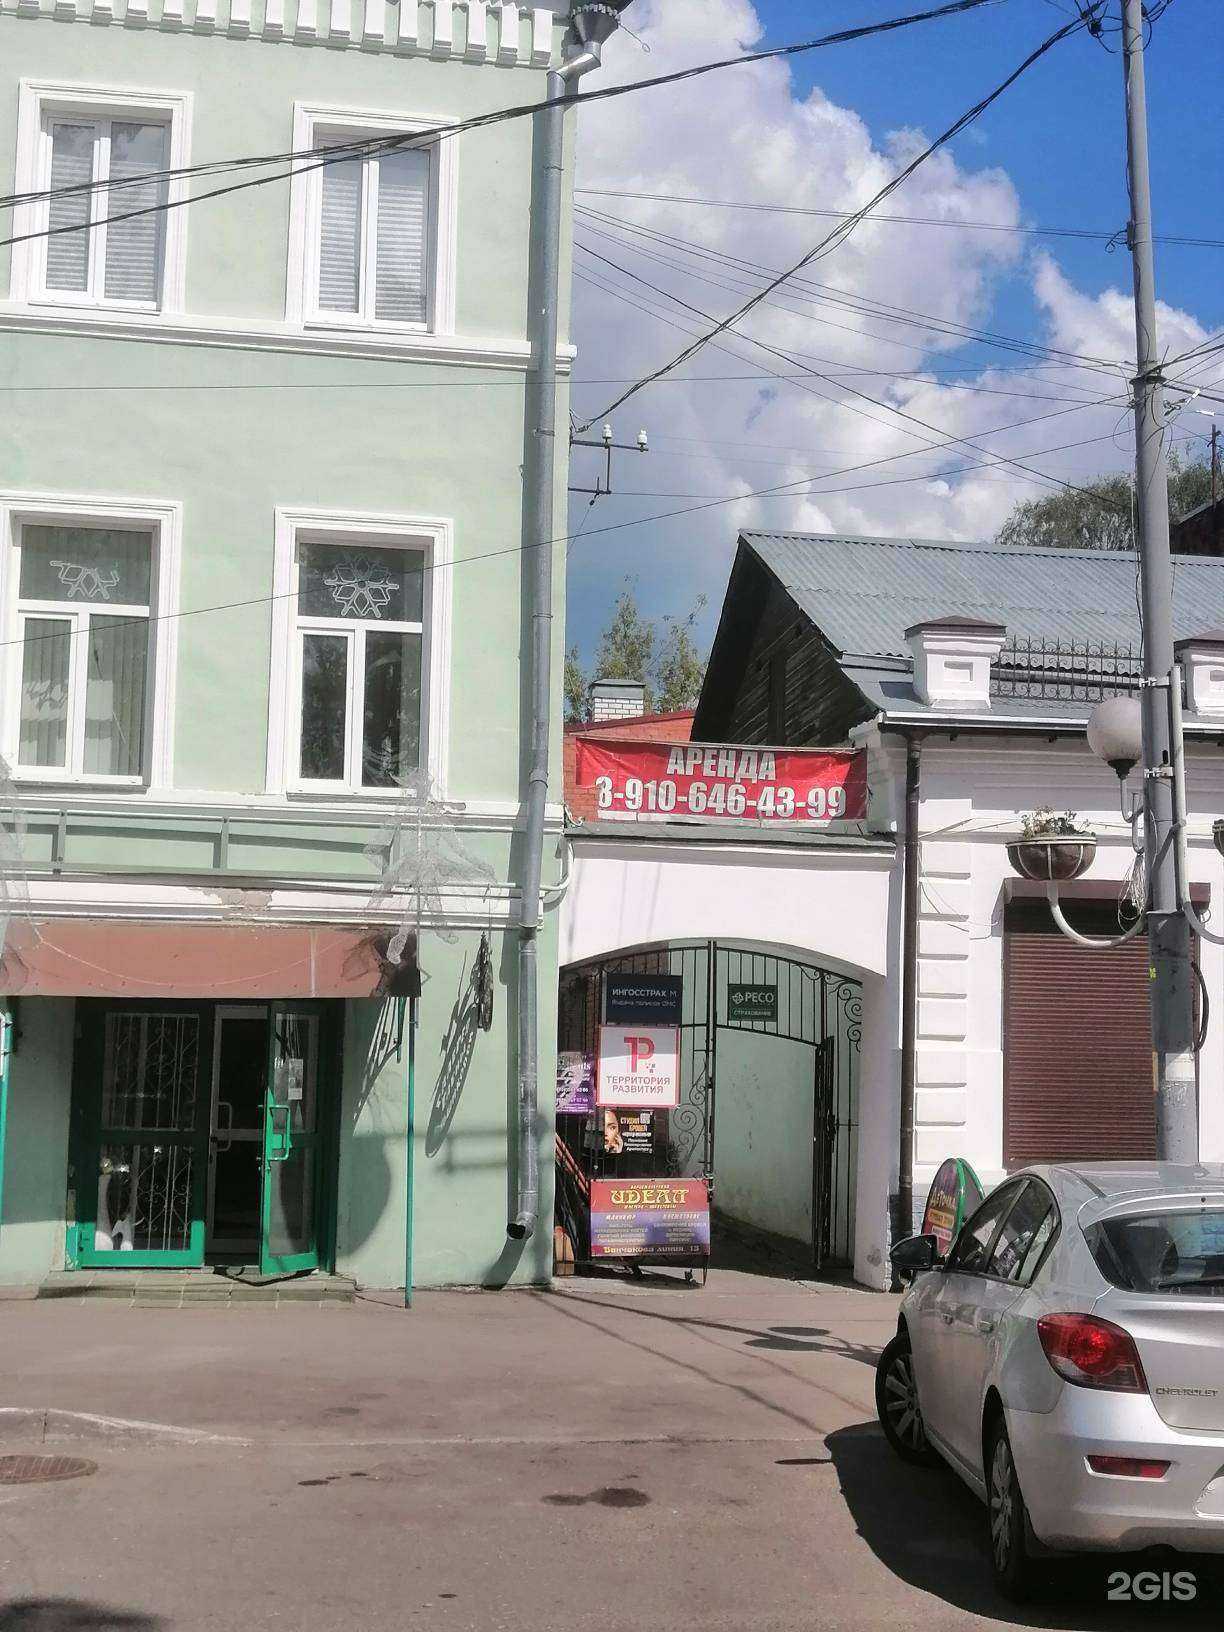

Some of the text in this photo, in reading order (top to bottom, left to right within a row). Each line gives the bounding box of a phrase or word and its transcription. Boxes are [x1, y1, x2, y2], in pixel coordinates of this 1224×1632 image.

[666, 747, 776, 783] АРЕНДА
[612, 988, 666, 997] ИНГОССТРАХ
[744, 991, 774, 1004] РЕСО
[606, 1075, 671, 1086] ТЕРРИТОРИЯ
[612, 1084, 664, 1094] РАЗВИТИЯ
[1155, 1387, 1219, 1397] CHEVROLET
